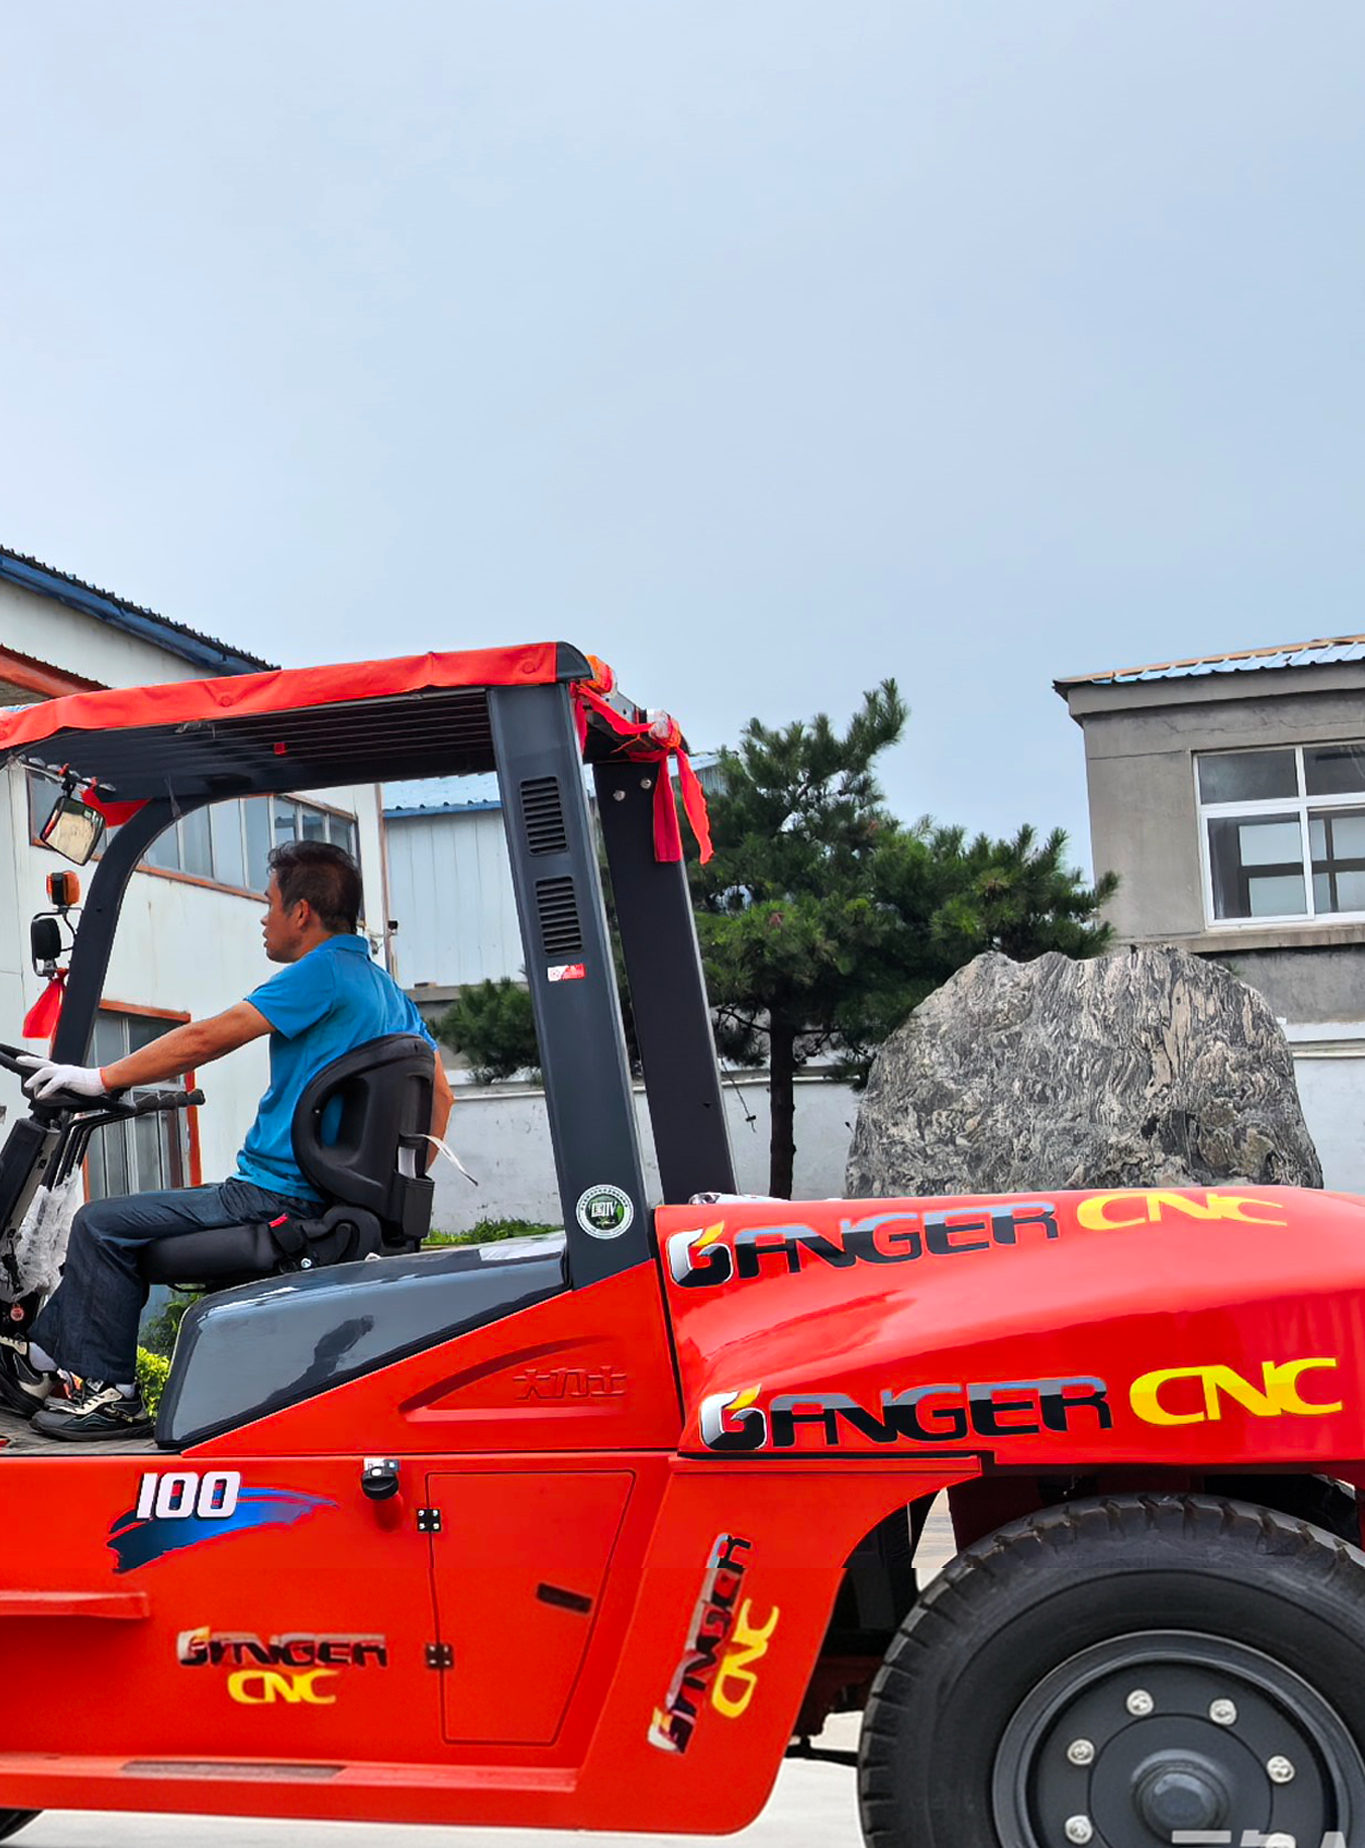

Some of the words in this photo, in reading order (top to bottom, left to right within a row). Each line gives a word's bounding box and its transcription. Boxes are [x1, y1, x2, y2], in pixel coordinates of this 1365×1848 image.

[1075, 1190, 1288, 1231] CNC
[1128, 1356, 1344, 1426] CNC
[136, 1470, 242, 1519] 100
[711, 1598, 780, 1719] CNC
[226, 1668, 340, 1705] CNC
